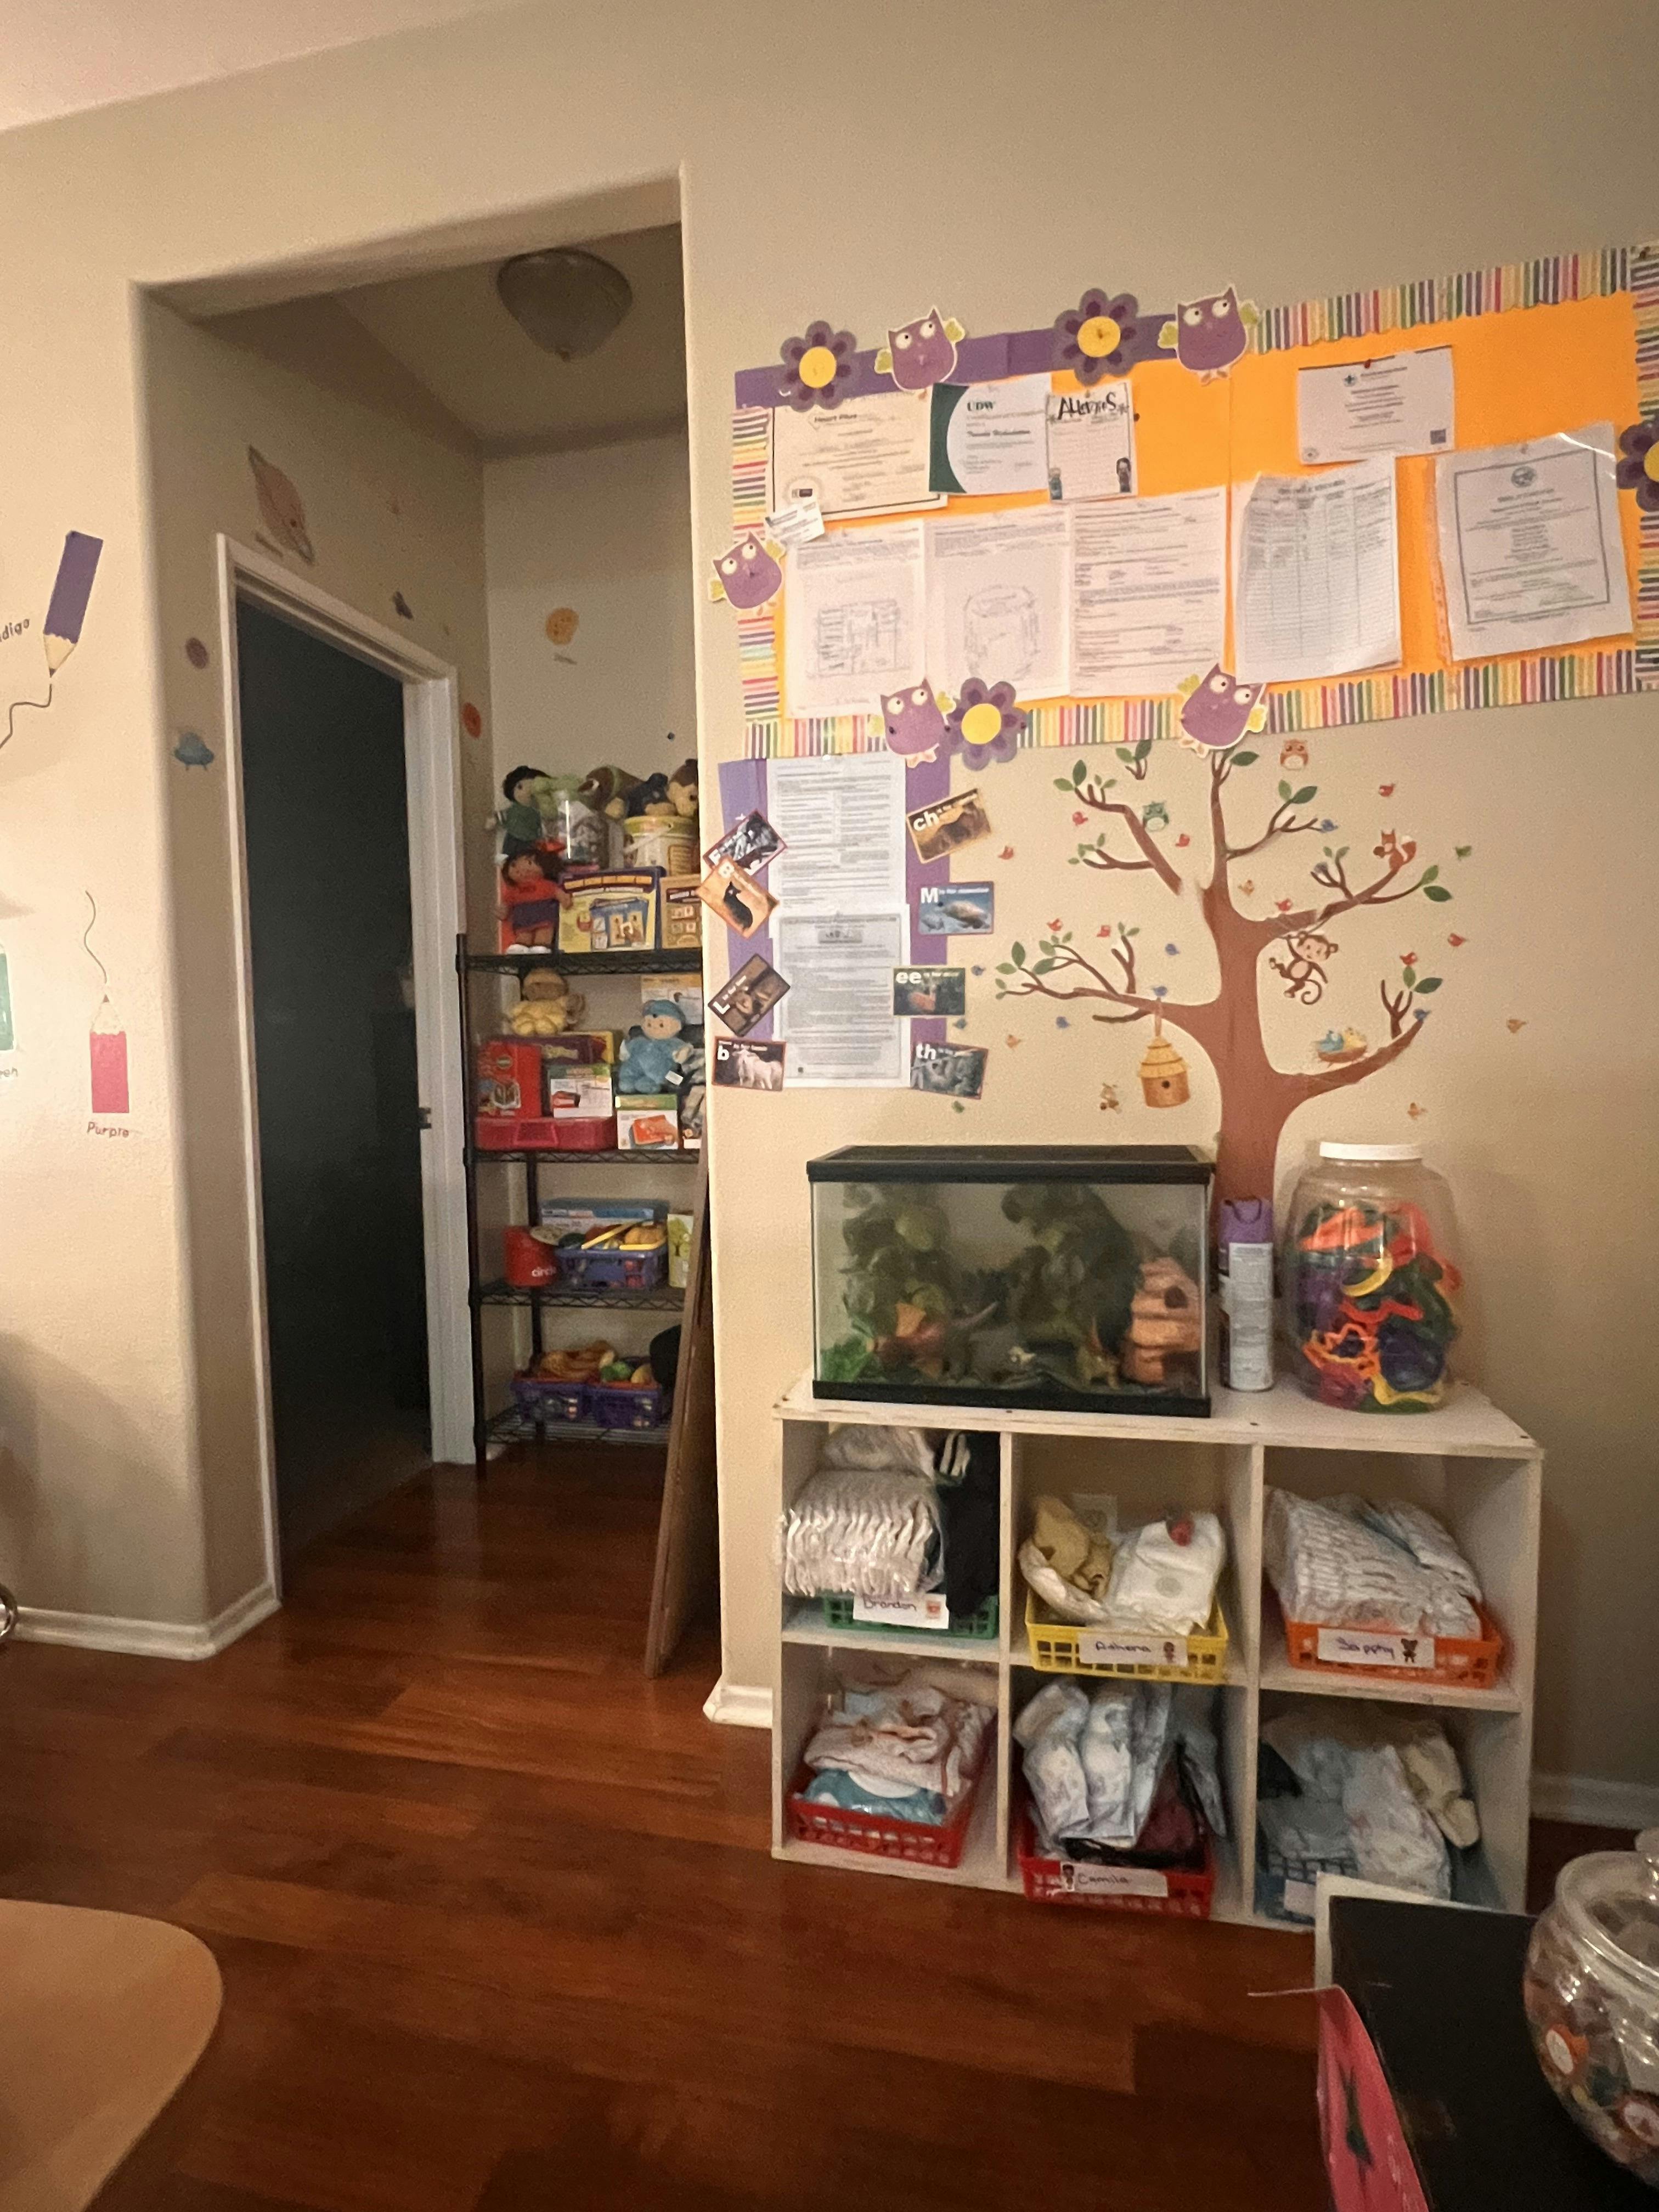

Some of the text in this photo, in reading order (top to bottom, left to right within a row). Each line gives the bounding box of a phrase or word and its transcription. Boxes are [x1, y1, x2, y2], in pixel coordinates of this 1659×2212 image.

[0, 619, 30, 642] digo
[913, 811, 940, 832] ch
[921, 887, 939, 904] M
[895, 971, 922, 984] ee
[713, 1001, 731, 1015] L
[916, 1042, 936, 1060] th
